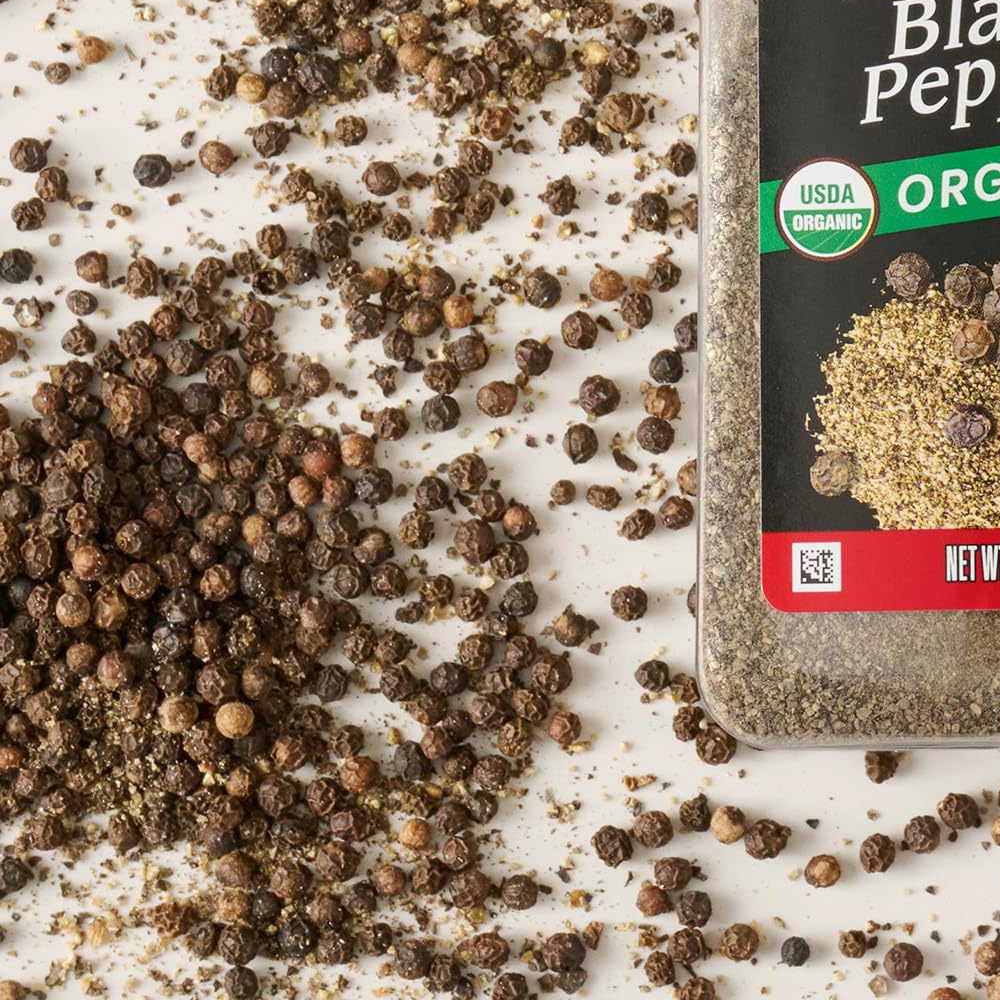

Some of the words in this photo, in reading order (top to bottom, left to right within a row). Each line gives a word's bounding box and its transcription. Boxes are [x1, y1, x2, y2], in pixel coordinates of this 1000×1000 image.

[800, 183, 856, 205] USDA
[792, 213, 863, 232] ORGANIC
[945, 544, 978, 582] NET
